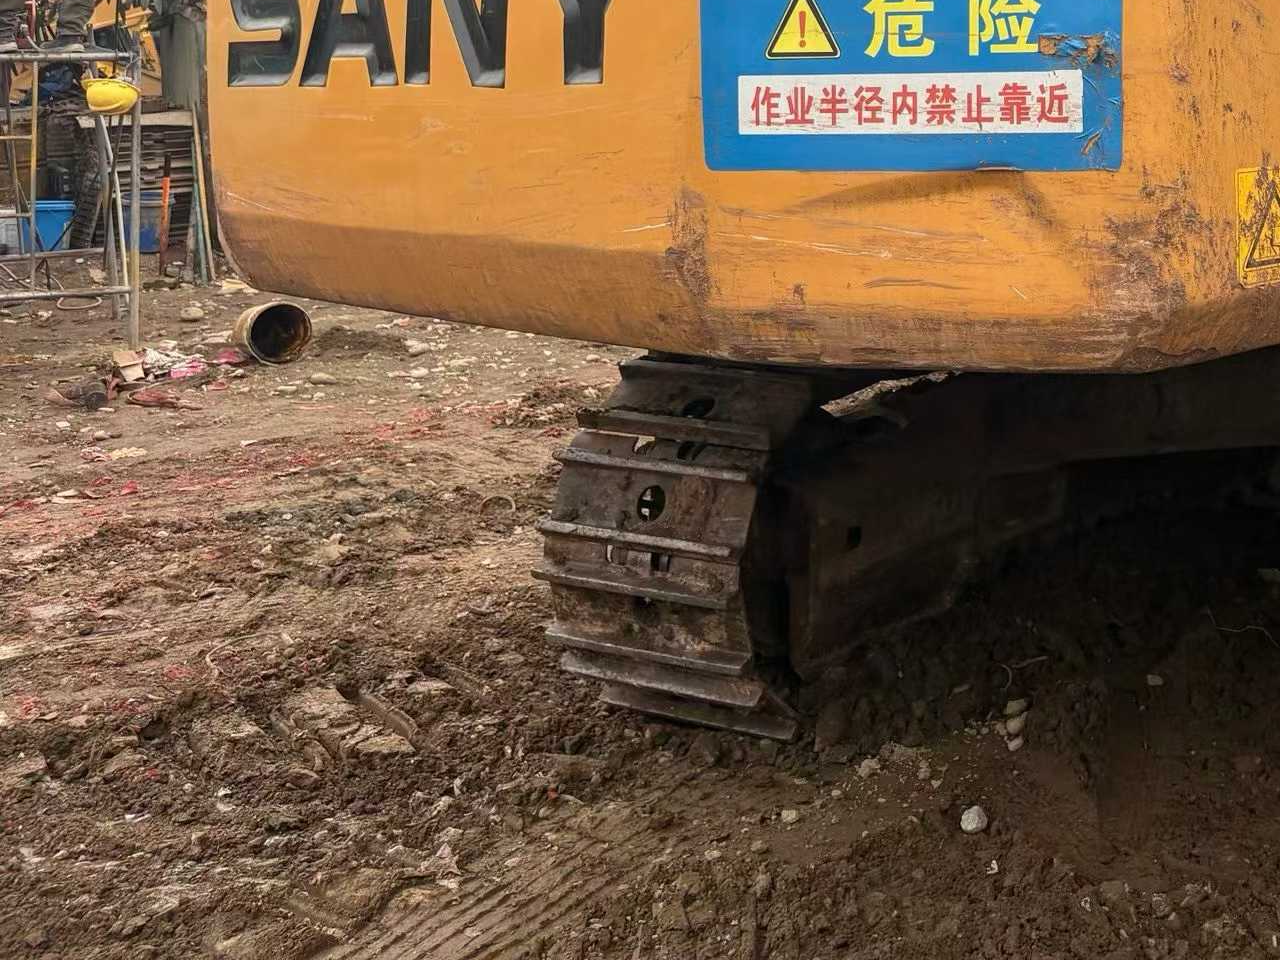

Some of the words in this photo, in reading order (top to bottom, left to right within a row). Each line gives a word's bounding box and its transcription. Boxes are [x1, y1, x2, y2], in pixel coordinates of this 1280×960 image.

[750, 83, 1070, 127] 作业半径内禁止靠近
